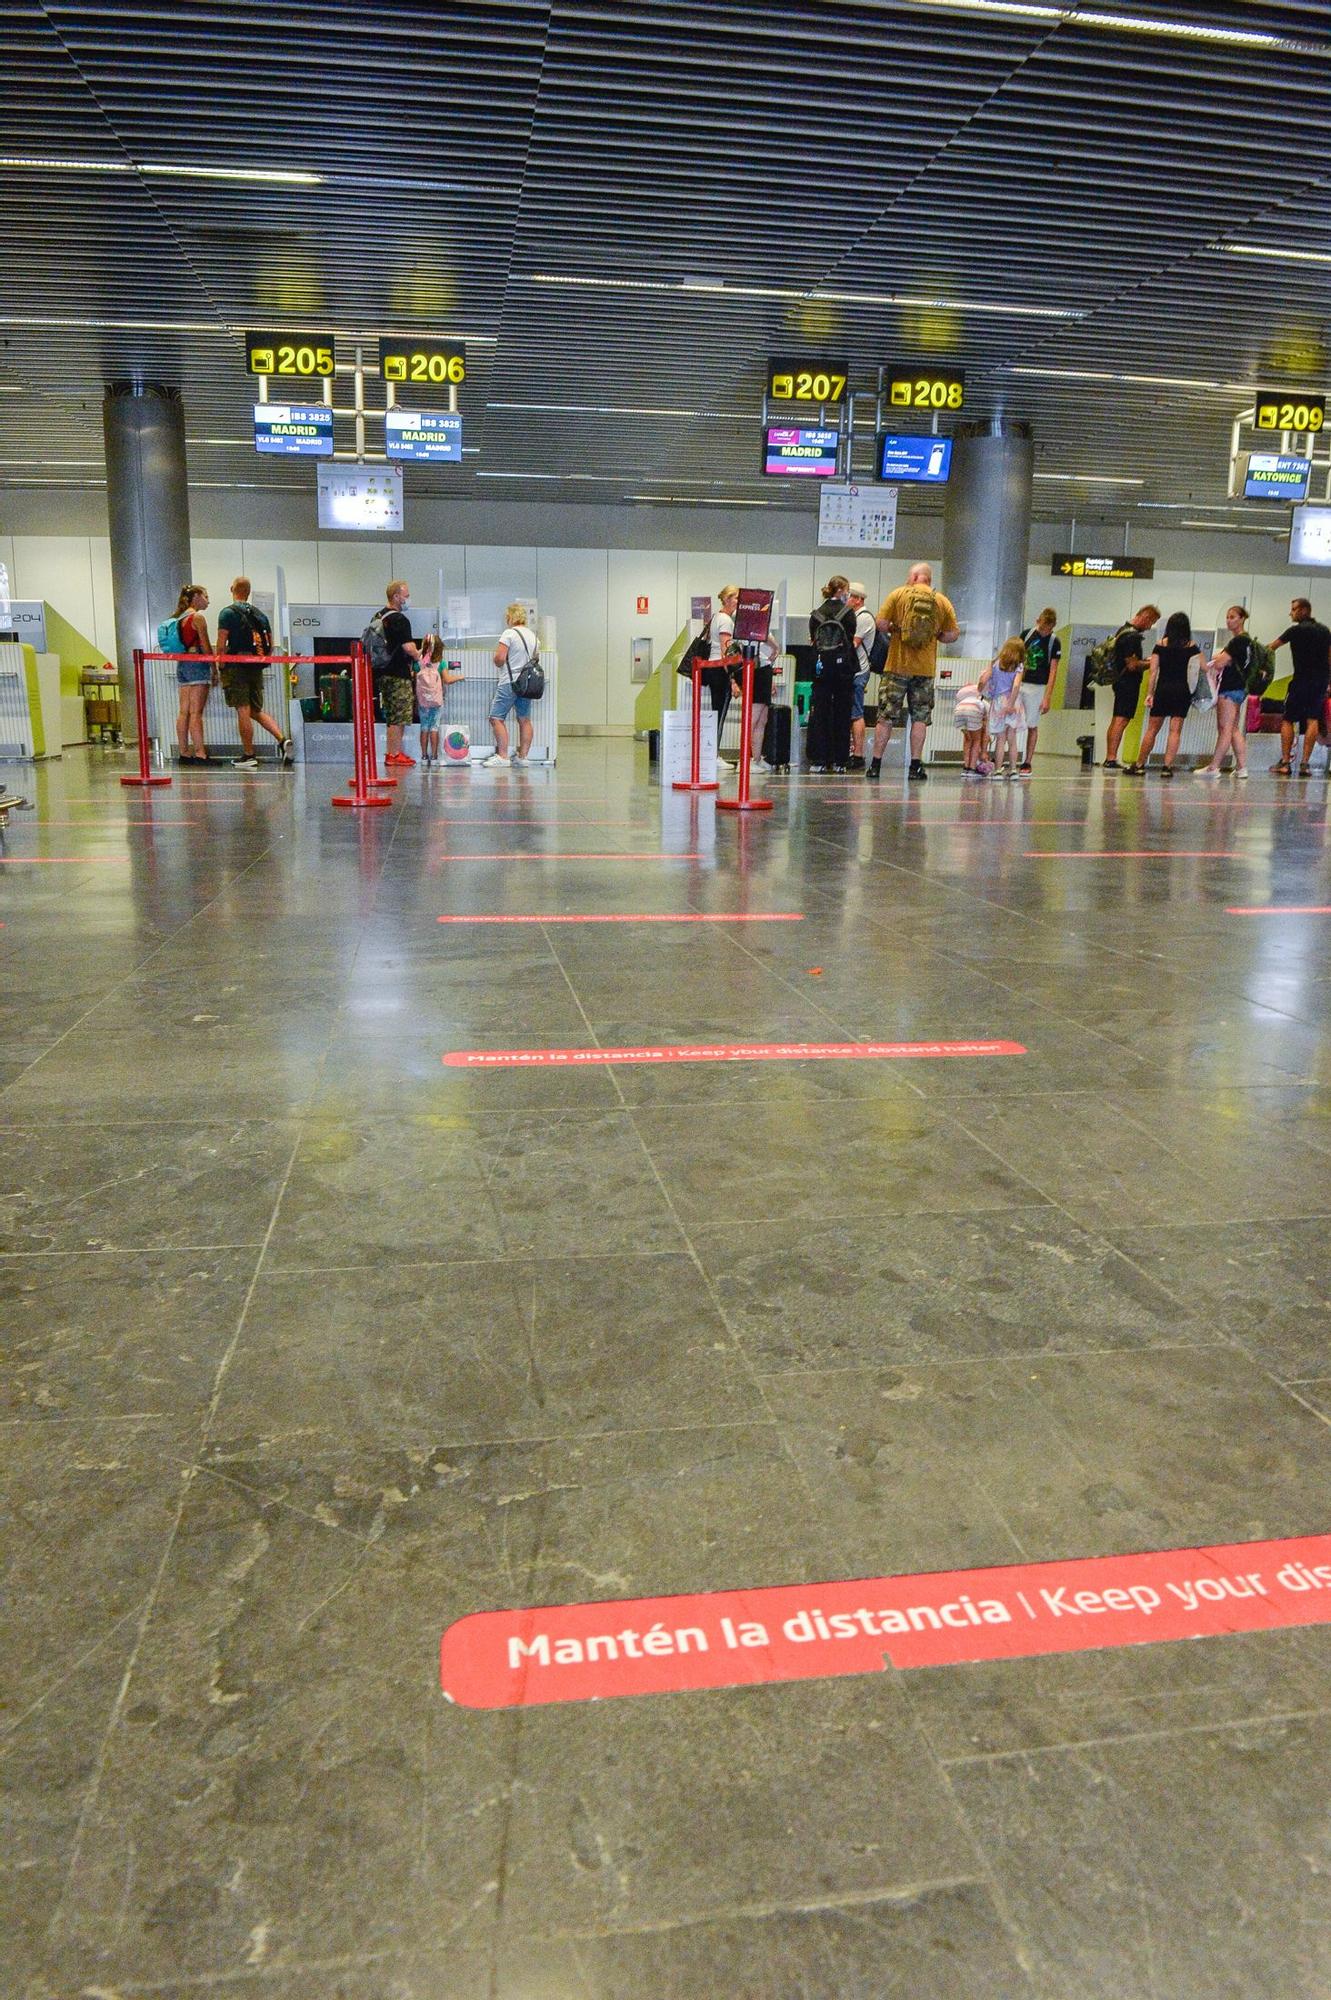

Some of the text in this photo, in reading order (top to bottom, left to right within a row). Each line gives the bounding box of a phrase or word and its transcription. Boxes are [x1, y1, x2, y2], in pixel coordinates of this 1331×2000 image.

[278, 347, 334, 375] 205
[410, 354, 465, 383] 206
[796, 373, 847, 401] 207
[914, 380, 963, 408] 208
[291, 412, 307, 420] IBS
[1279, 404, 1324, 431] 209
[421, 419, 437, 427] IBS
[271, 424, 317, 436] MADRID
[402, 431, 446, 442] MADRID
[781, 446, 823, 457] MADRID
[1253, 471, 1302, 483] KATOWICE
[12, 614, 41, 622] 204
[292, 618, 321, 627] 205
[467, 1053, 544, 1062] Mantén
[573, 1052, 663, 1060] distancia
[677, 1049, 726, 1057] Keep
[776, 1047, 853, 1055] distance
[508, 1623, 709, 1669] Mantén
[720, 1617, 770, 1649] la
[783, 1594, 1012, 1642] distancia
[1040, 1584, 1161, 1617] Keep
[1166, 1571, 1268, 1610] your
